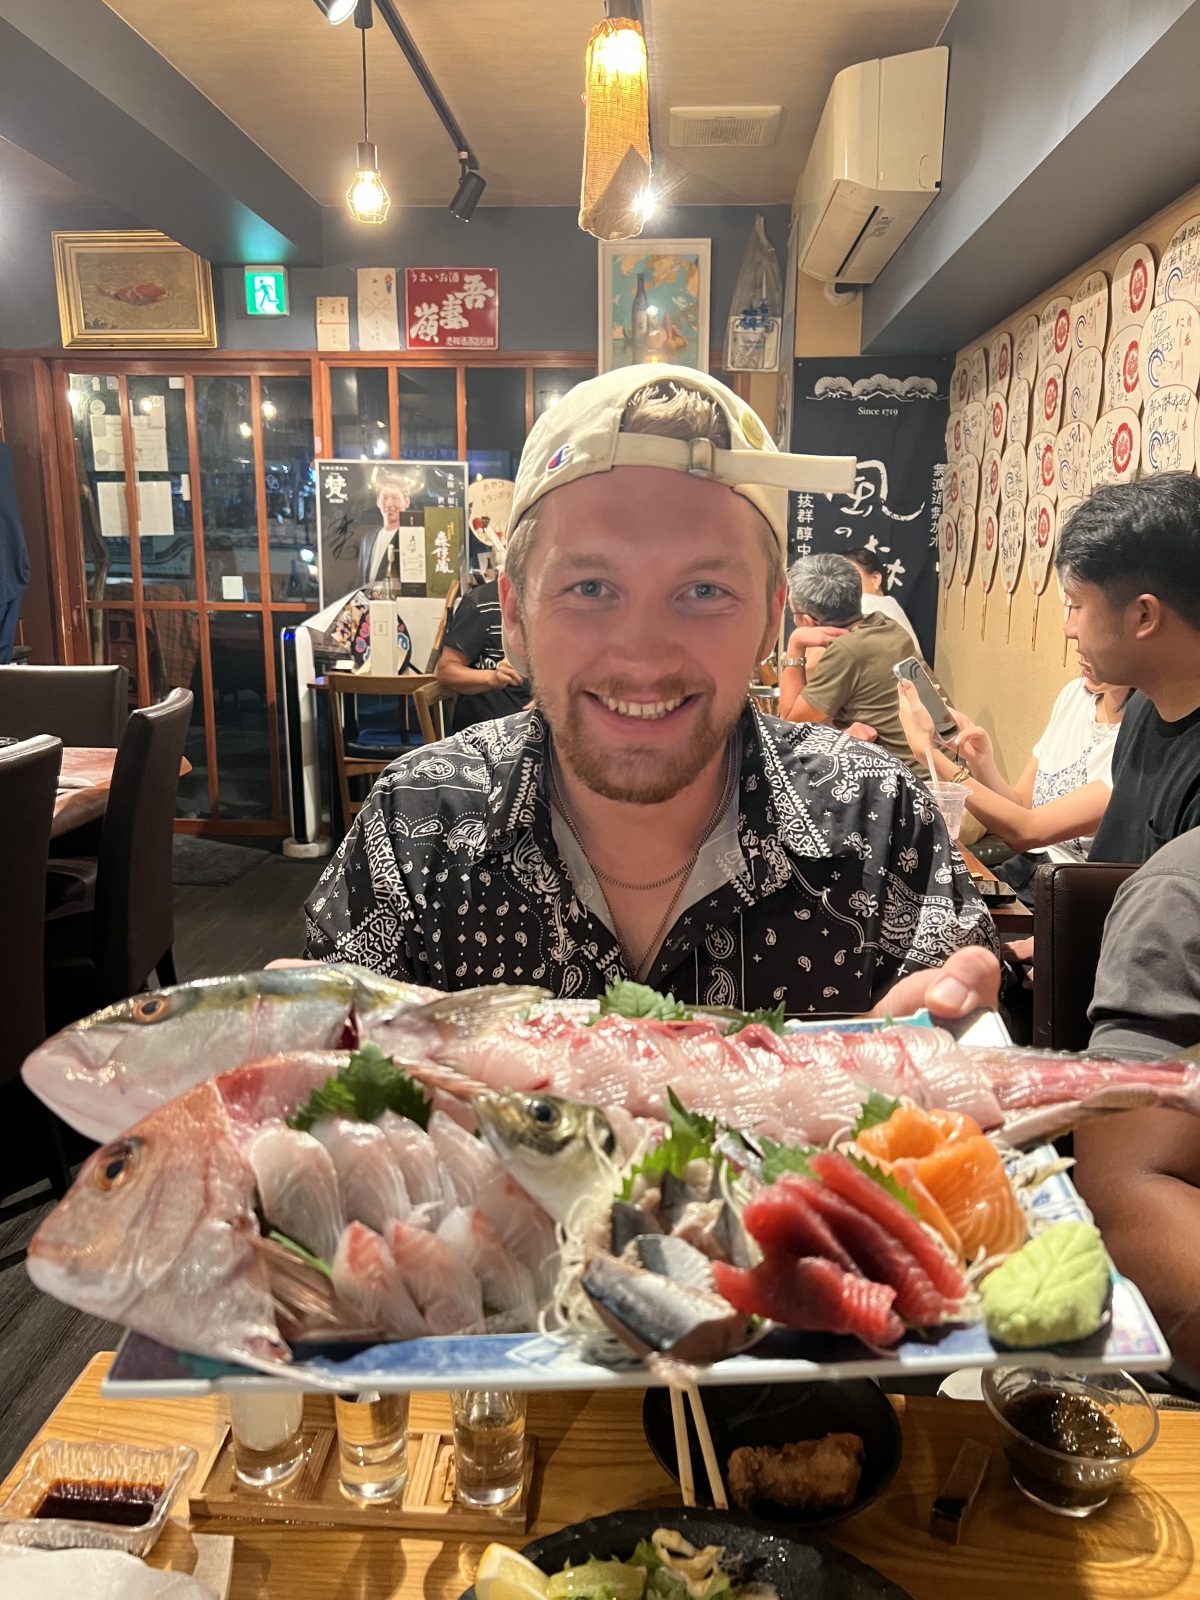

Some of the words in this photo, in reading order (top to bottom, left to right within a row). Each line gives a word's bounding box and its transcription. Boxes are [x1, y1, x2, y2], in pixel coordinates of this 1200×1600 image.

[411, 269, 460, 283] うまいお酒
[857, 406, 880, 416] Since
[881, 408, 899, 417] 1719
